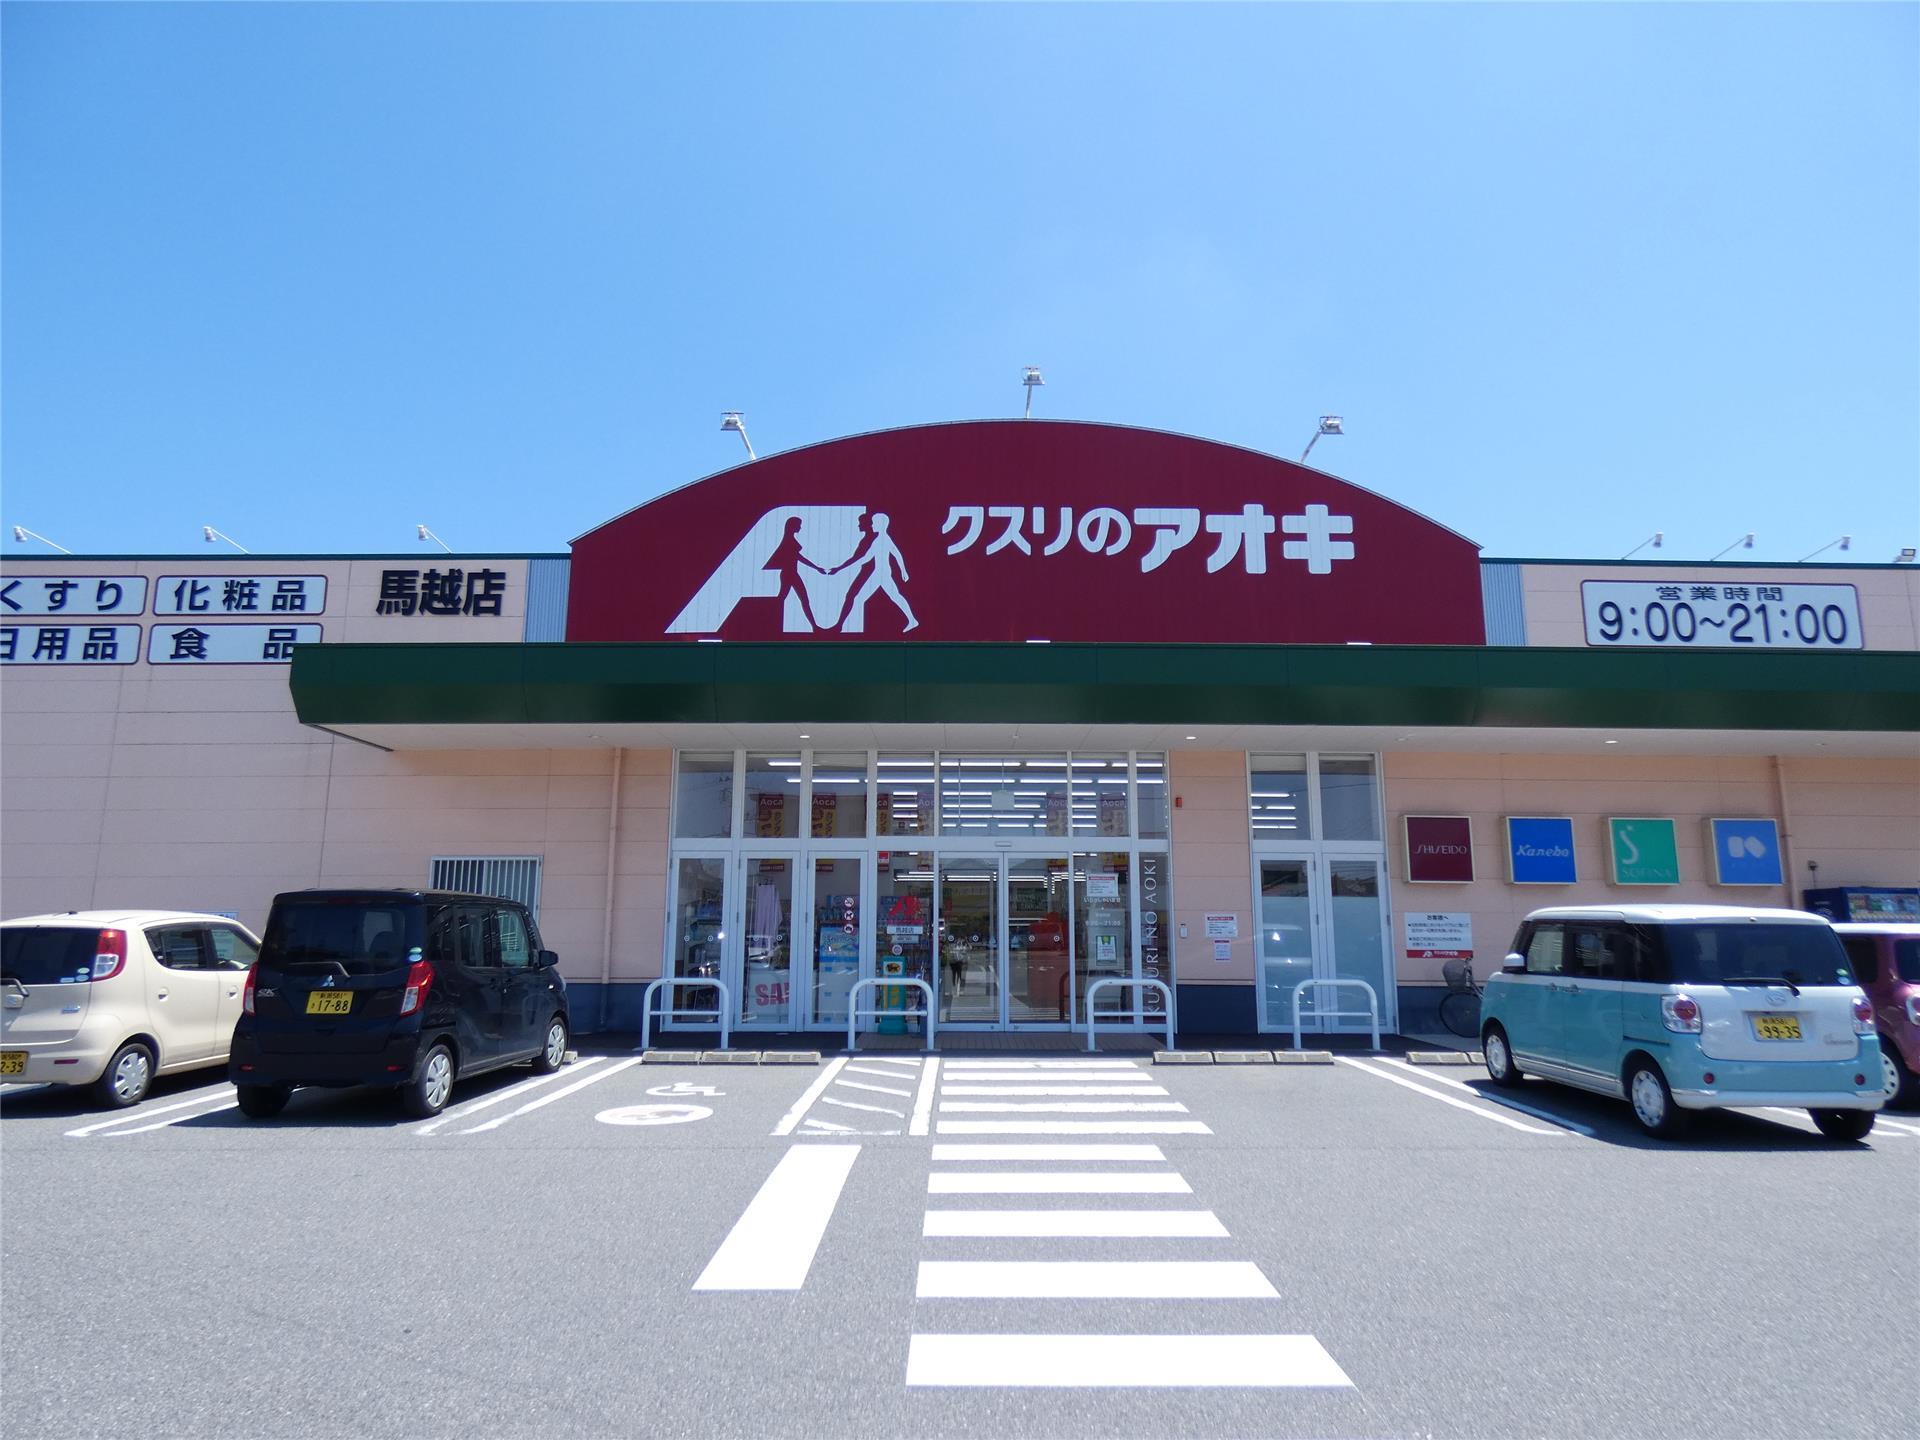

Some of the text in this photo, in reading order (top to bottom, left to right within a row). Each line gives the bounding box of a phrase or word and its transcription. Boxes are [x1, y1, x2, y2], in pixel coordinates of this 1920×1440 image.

[942, 503, 1355, 575] クスリのアオキ
[0, 579, 123, 612] くすり
[173, 579, 308, 612] 化粧品
[376, 569, 507, 617] 馬越店
[1656, 586, 1783, 602] 営業時間
[1415, 845, 1467, 855] SHISEIDO
[1516, 845, 1569, 857] Kanebo
[1143, 859, 1157, 904] AOKI
[1145, 911, 1158, 939] NO
[318, 1000, 349, 1011] 17-88
